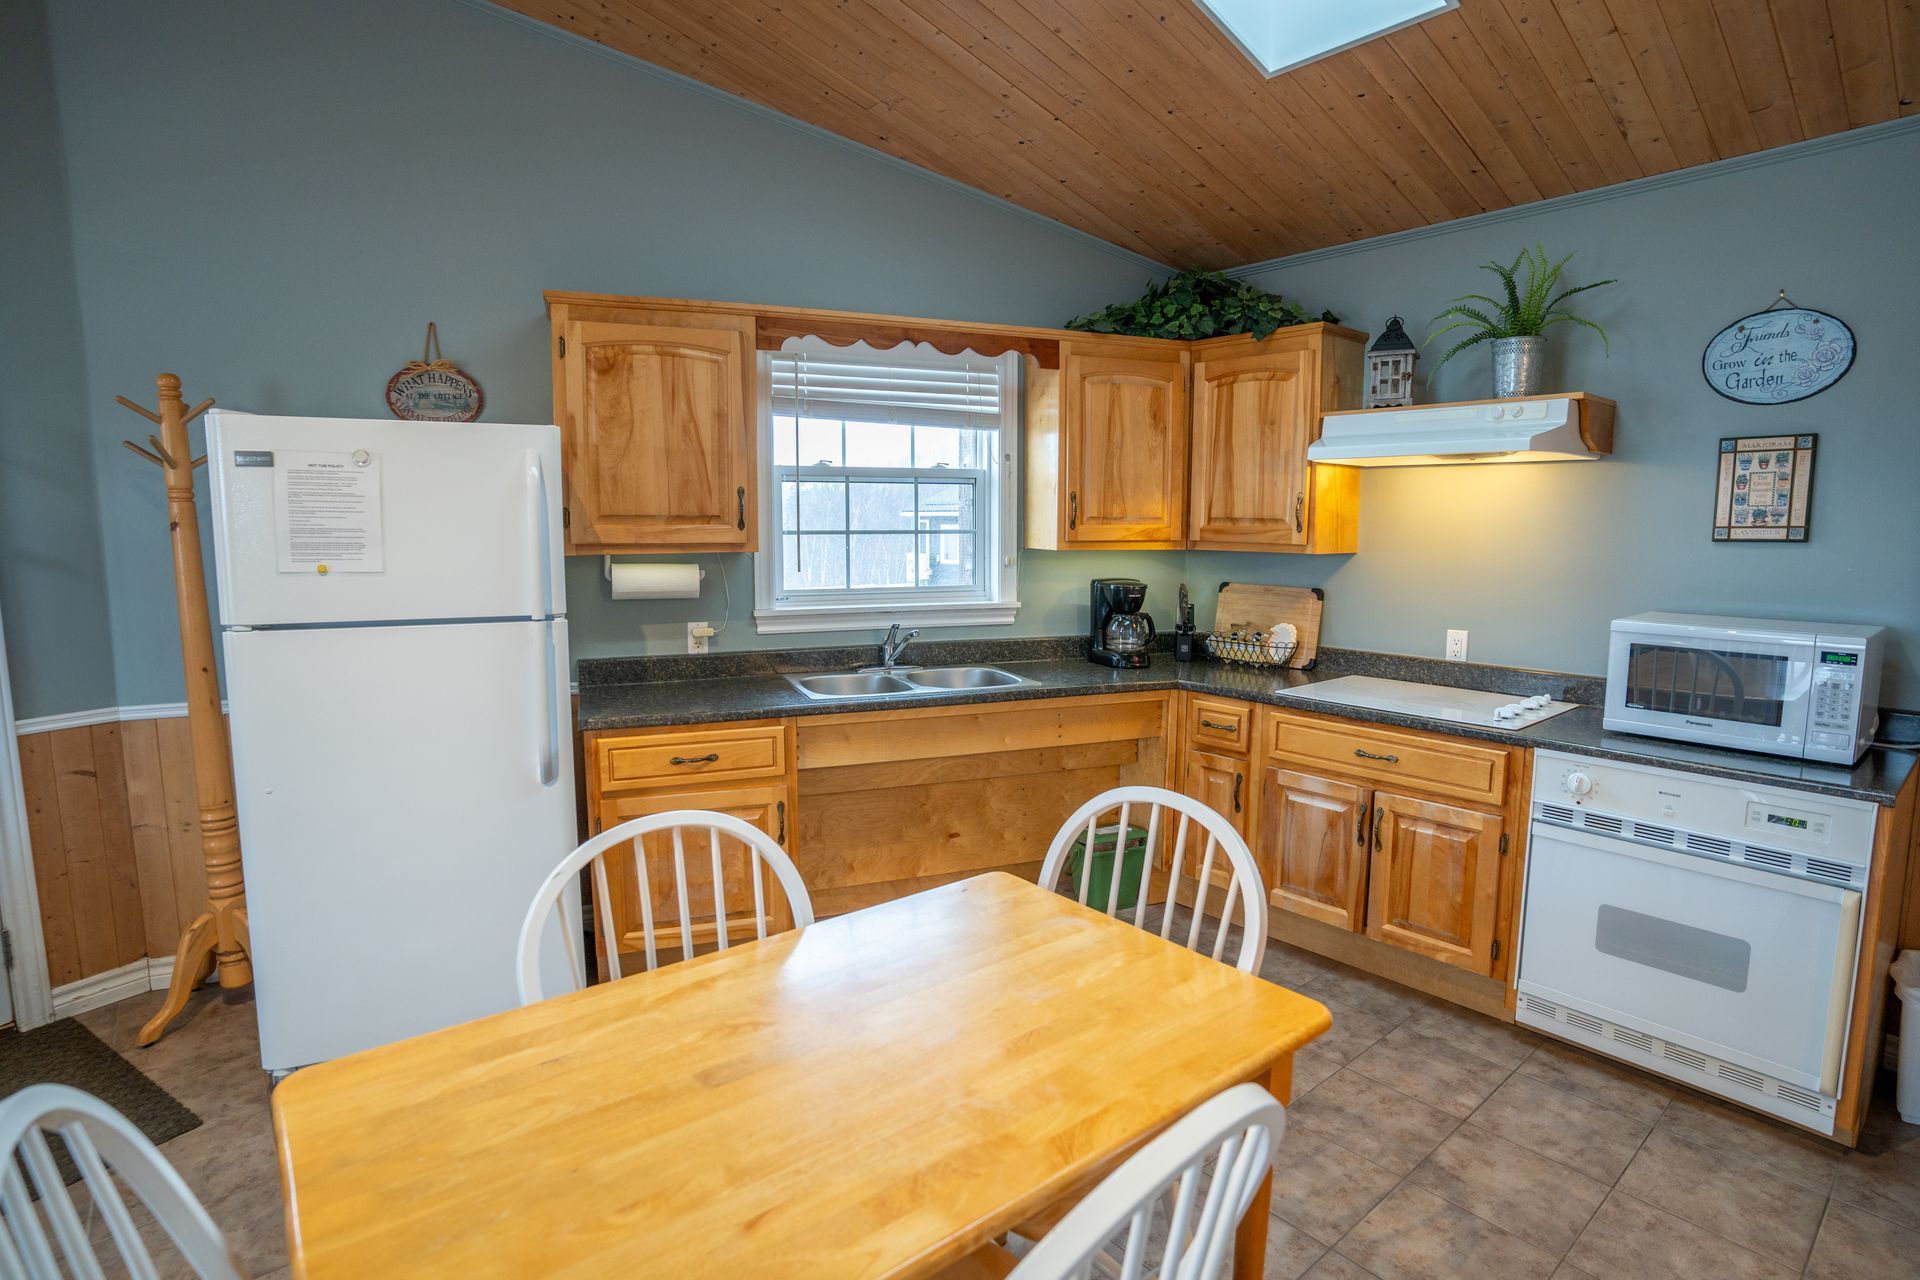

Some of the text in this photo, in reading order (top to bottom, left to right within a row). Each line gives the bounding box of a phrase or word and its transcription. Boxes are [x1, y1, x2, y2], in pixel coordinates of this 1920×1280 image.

[1724, 321, 1791, 356] Friends
[1712, 348, 1798, 372] Grow in the
[394, 372, 475, 398] WHAT HAPPENS
[1725, 368, 1784, 391] Garden
[1685, 719, 1713, 728] Panasonic
